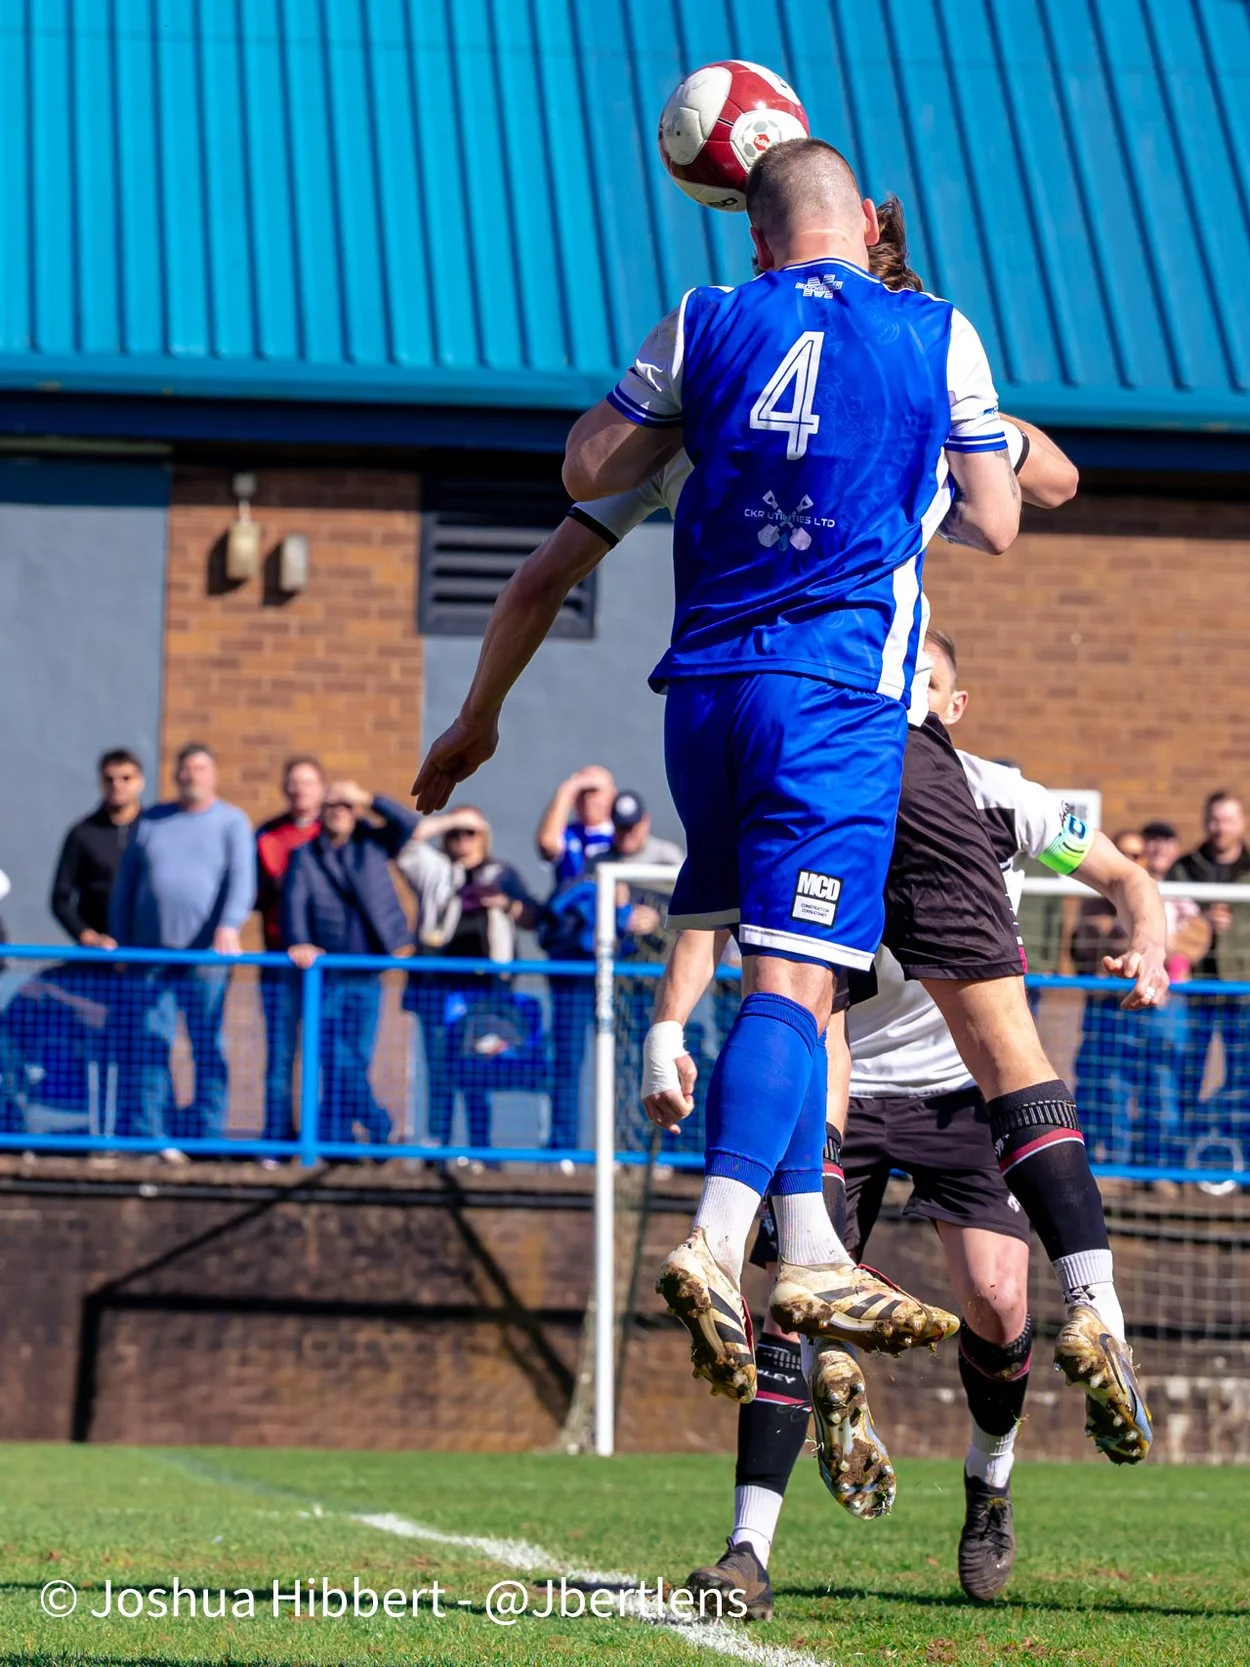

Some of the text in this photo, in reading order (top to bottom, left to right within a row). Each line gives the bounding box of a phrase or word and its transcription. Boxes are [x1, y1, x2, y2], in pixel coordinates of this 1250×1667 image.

[749, 331, 825, 460] 4
[744, 508, 765, 518] CKR
[814, 518, 836, 528] LTD
[796, 871, 841, 902] MCD
